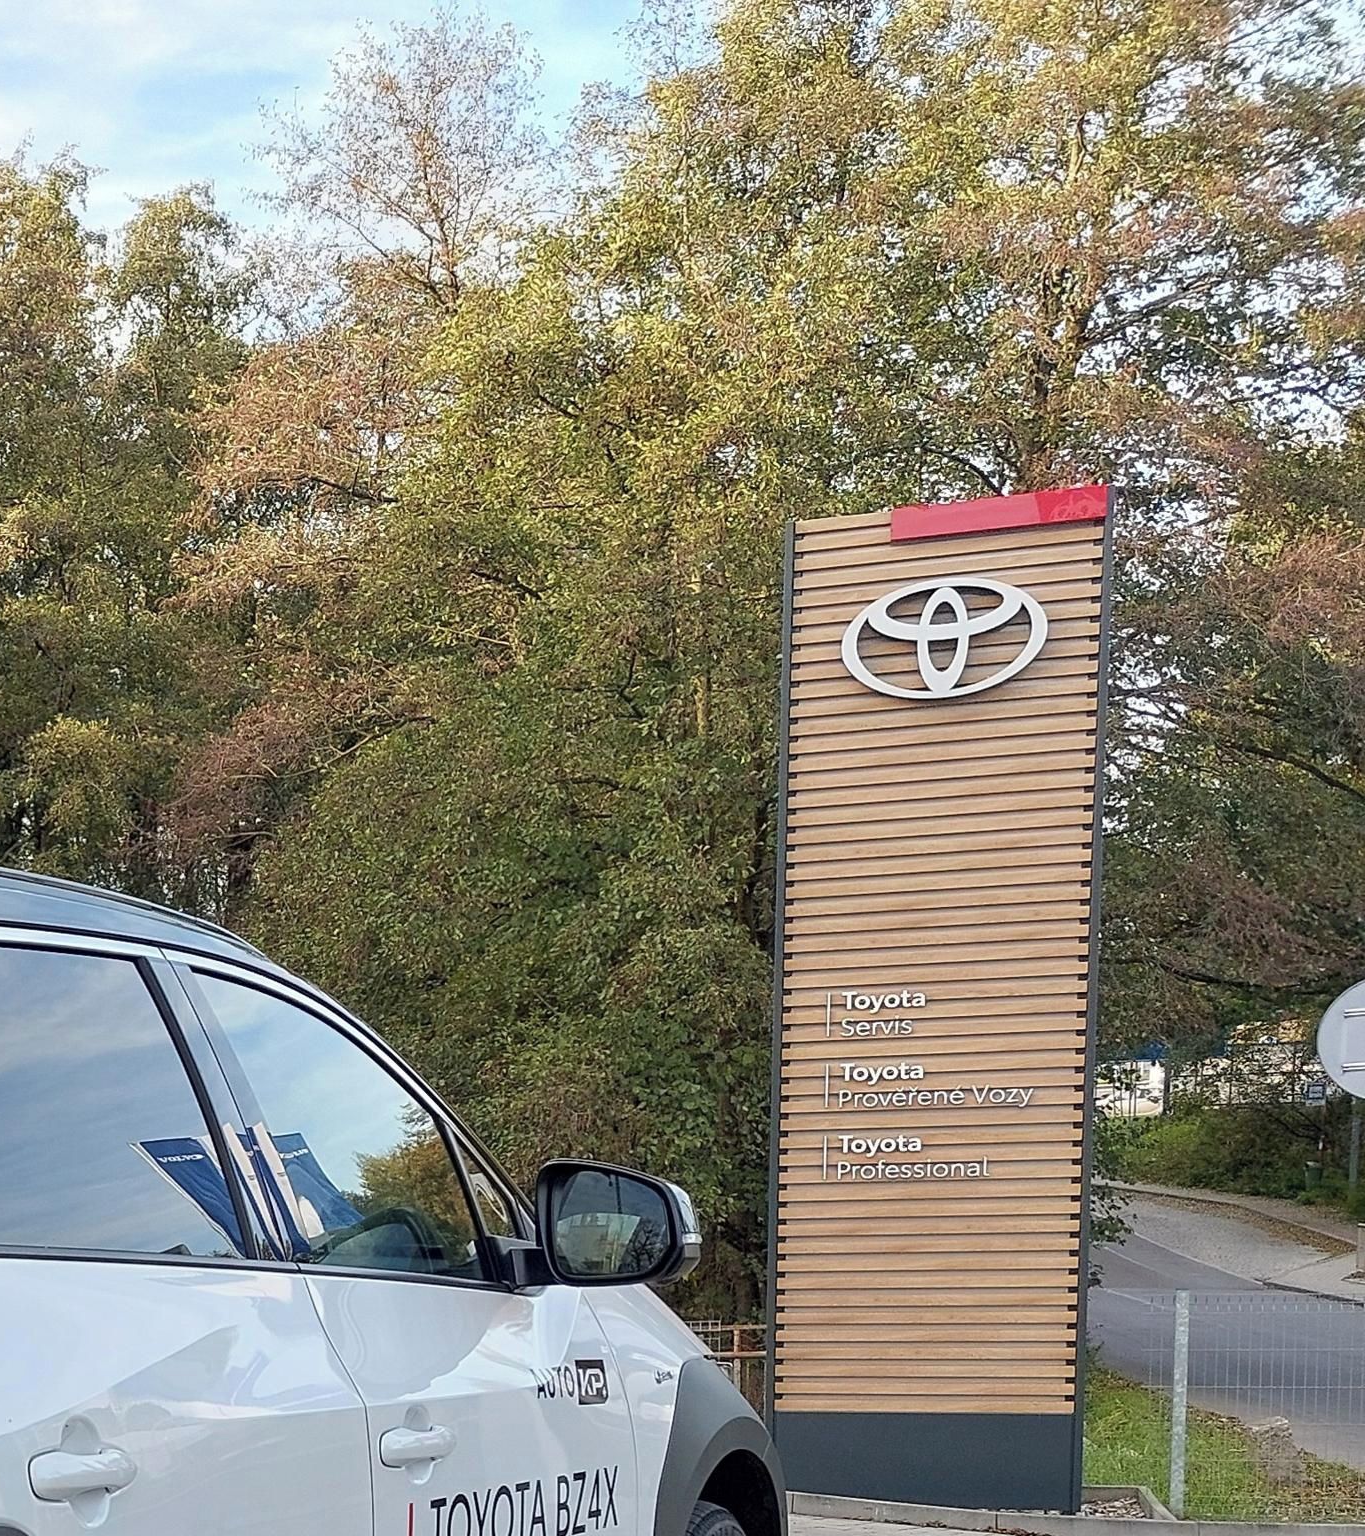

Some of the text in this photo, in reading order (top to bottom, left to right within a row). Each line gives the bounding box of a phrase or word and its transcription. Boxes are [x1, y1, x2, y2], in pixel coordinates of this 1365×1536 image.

[842, 990, 927, 1014] Toyota
[840, 1016, 913, 1037] Servis
[840, 1062, 924, 1085] Toyota
[838, 1084, 1035, 1108] Prověřené Vozy
[838, 1135, 922, 1158] Toyota
[837, 1156, 990, 1180] Professional
[530, 1366, 575, 1399] AUTO
